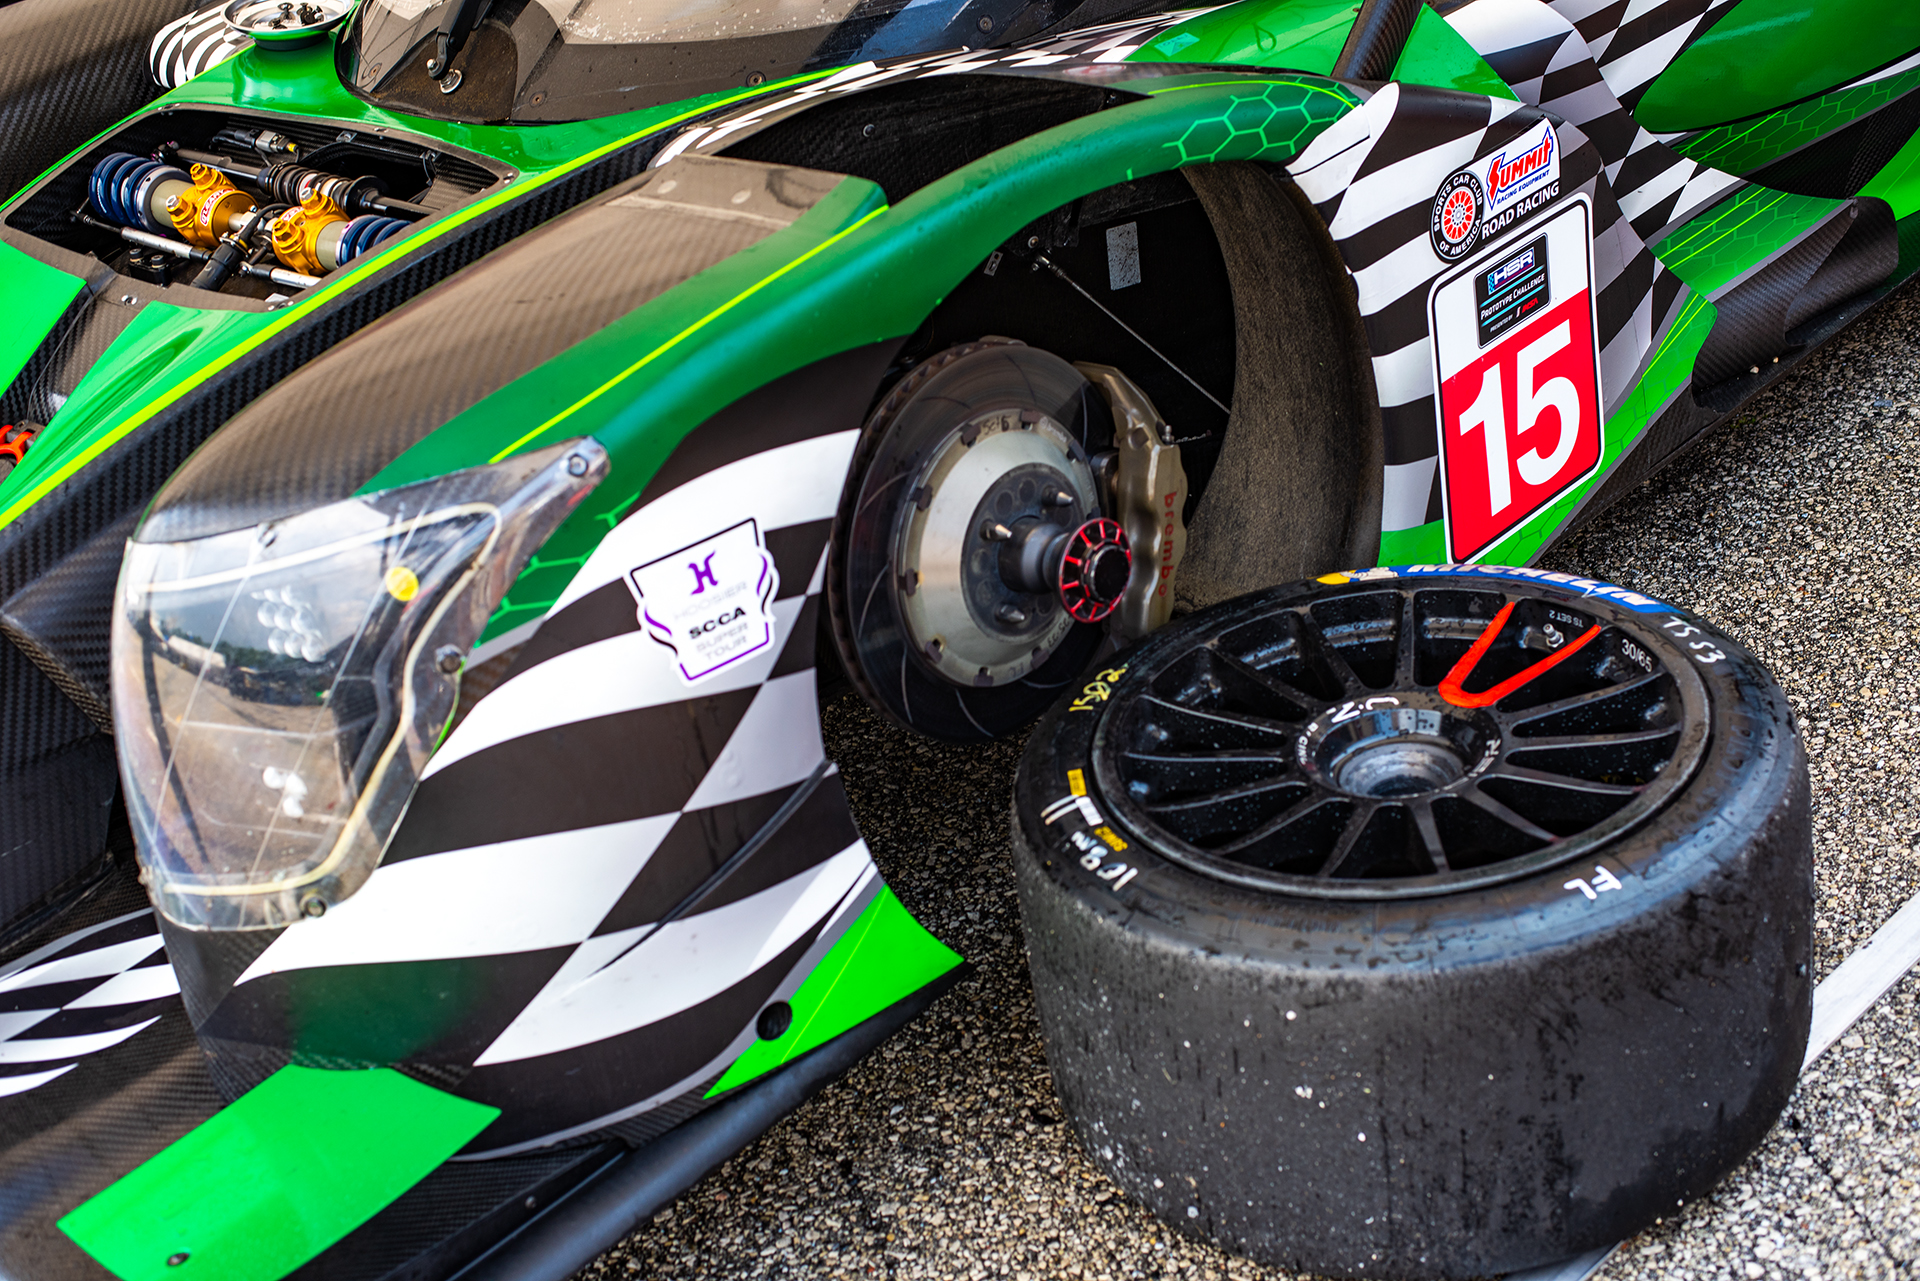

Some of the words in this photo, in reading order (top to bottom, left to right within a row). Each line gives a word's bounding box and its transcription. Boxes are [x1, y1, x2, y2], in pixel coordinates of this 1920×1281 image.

[1434, 183, 1452, 232] SPORTS
[1453, 174, 1470, 187] CAR
[1470, 178, 1483, 206] CLUB
[1497, 188, 1518, 205] RACING
[1519, 169, 1550, 192] EQUIPMENT
[1482, 210, 1515, 240] ROAD
[1516, 181, 1560, 218] RACING
[1439, 240, 1450, 253] OF
[1493, 250, 1533, 285] HSR
[1481, 293, 1513, 321] PROTOTYPE
[1513, 273, 1546, 300] CHALLENGE
[1459, 319, 1580, 517] 15
[1158, 491, 1177, 597] brembo
[674, 581, 748, 620] HOOSIER
[1407, 564, 1659, 606] MICHELIN
[689, 607, 746, 639] SCCA
[1549, 609, 1556, 619] 2
[1556, 612, 1573, 625] SET
[1572, 617, 1584, 628] TS
[696, 622, 748, 652] SUPER
[705, 635, 747, 661] TOUR
[1621, 638, 1653, 673] 30/65
[1563, 865, 1622, 900] FL
